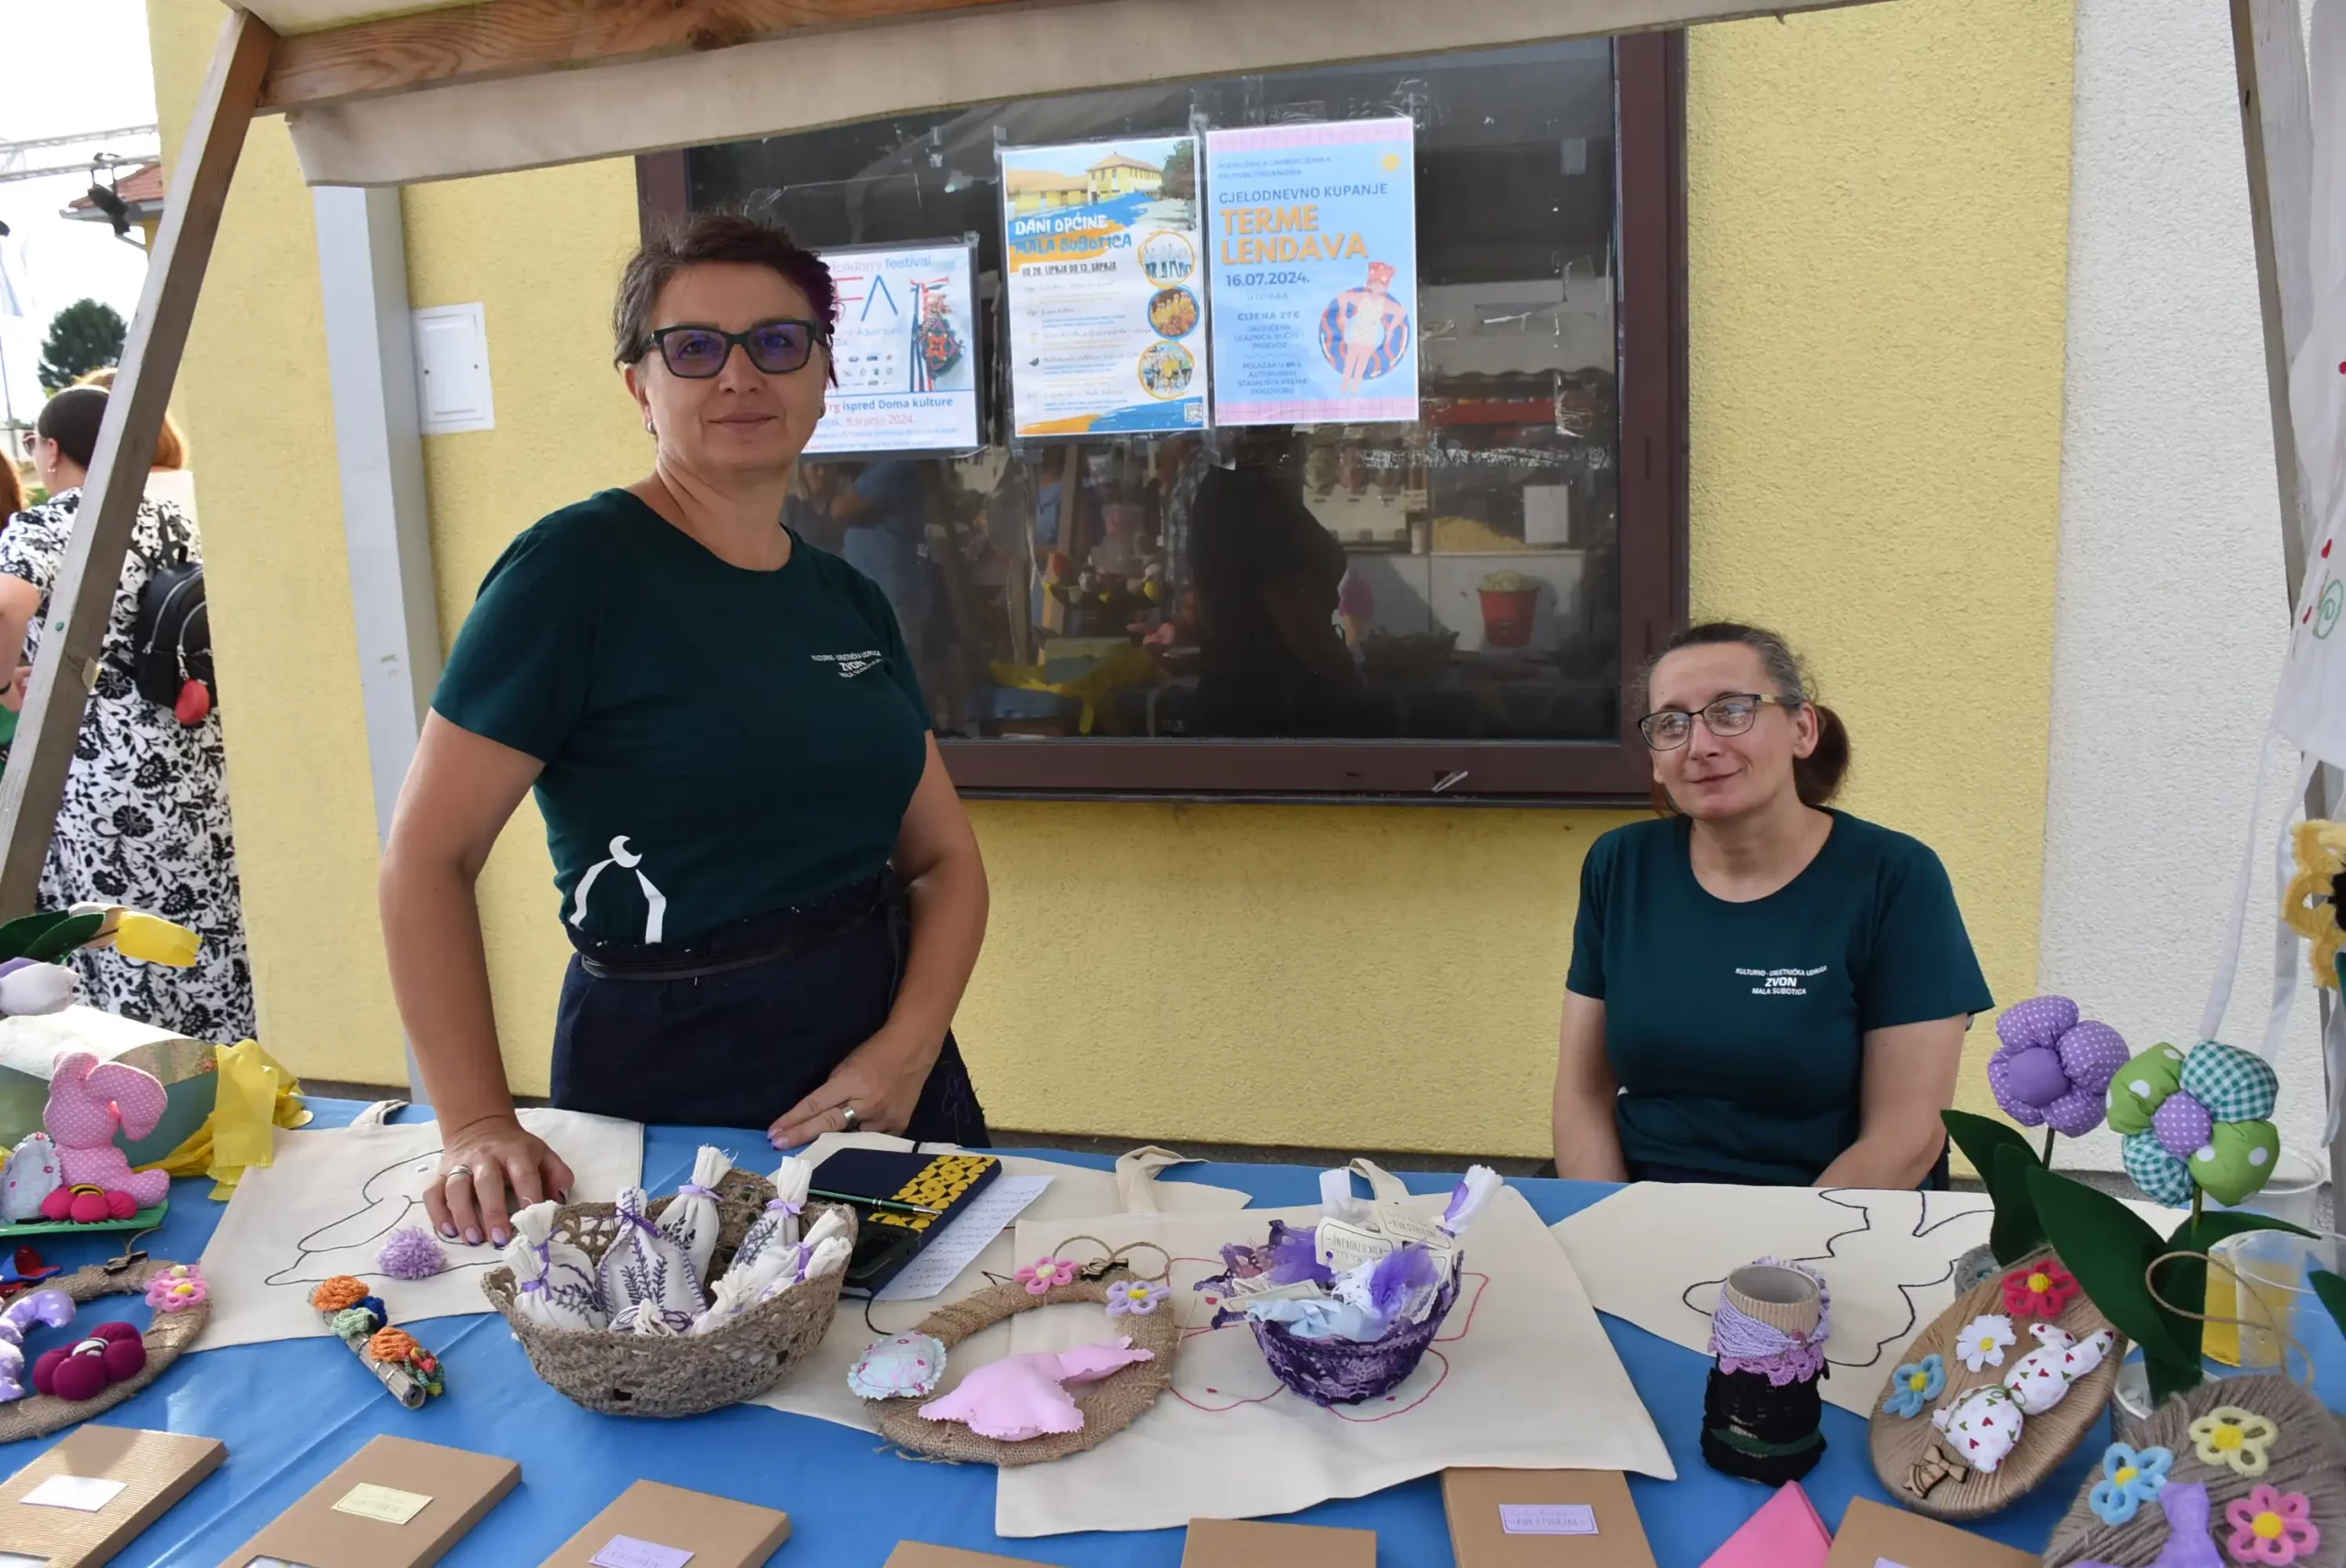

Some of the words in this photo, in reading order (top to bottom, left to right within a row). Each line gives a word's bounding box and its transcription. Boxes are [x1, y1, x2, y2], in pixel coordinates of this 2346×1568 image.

[1219, 187, 1320, 203] CJELODNEVNO
[1324, 182, 1388, 197] KUPANJE
[1014, 219, 1049, 236] DANI
[1055, 214, 1108, 233] OPĆINE
[1220, 203, 1320, 236] TERME
[1059, 233, 1132, 252] SUBOTICA
[1221, 232, 1369, 265] LENDAVA
[885, 256, 931, 269] festival
[1225, 271, 1310, 287] 16.07.2024.
[1237, 312, 1277, 322] CIJENA
[842, 400, 875, 412] ispred
[878, 398, 909, 410] Doma
[912, 396, 953, 409] kulture
[1764, 977, 1797, 987] ZVON
